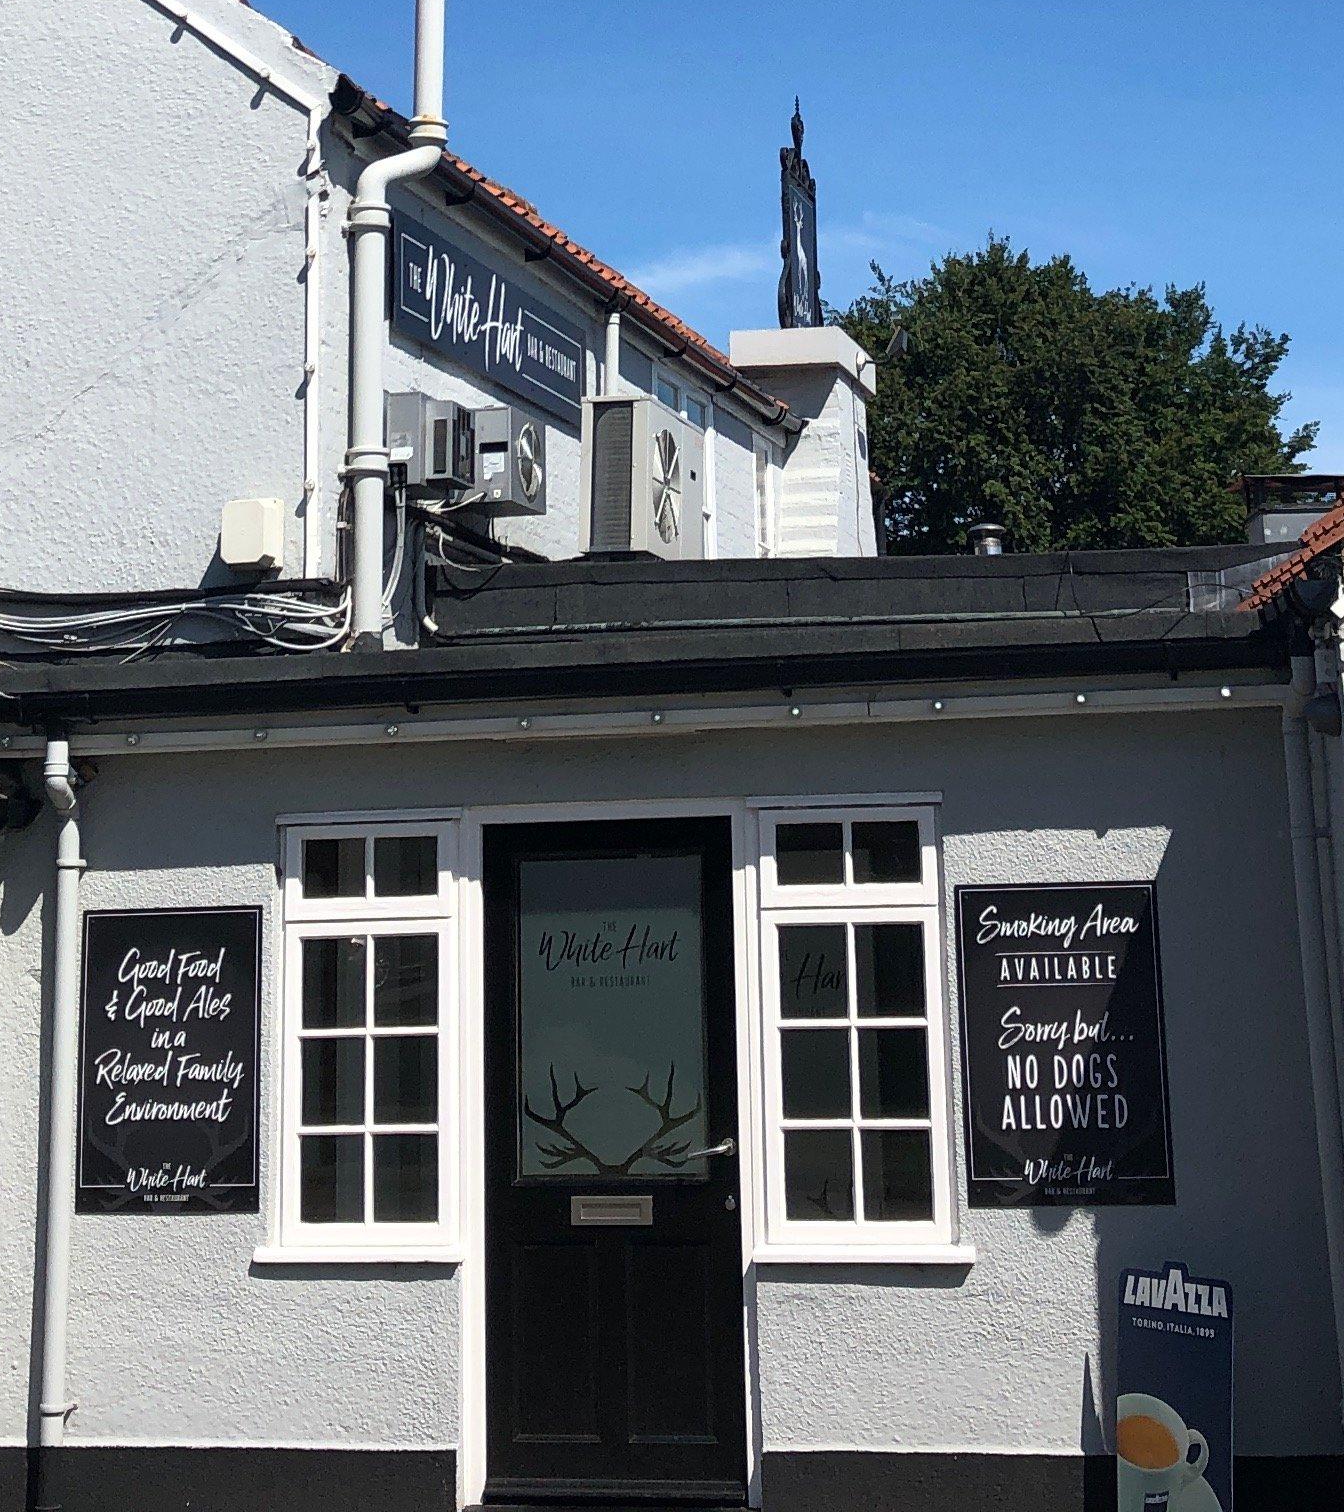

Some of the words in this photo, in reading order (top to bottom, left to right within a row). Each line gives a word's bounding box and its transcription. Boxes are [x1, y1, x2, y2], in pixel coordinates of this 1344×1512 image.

[409, 262, 422, 293] THE
[425, 244, 481, 344] White
[480, 274, 524, 372] Hart
[602, 921, 617, 933] THE
[976, 904, 1078, 948] Smoking
[1079, 903, 1139, 940] Area
[538, 930, 613, 971] White
[616, 923, 681, 969] Hart
[118, 947, 176, 990] Good
[177, 947, 226, 985] Food
[599, 975, 650, 987] RESTAURANT
[1000, 955, 1117, 981] AVAILABLE
[105, 989, 119, 1021] &
[125, 985, 182, 1029] Good
[182, 984, 233, 1022] Ales
[150, 1028, 172, 1049] in
[173, 1030, 187, 1047] a
[998, 1006, 1071, 1050] Sorry
[94, 1048, 174, 1089] Relaxed
[176, 1050, 245, 1089] Family
[1007, 1054, 1038, 1089] NO
[1054, 1053, 1118, 1089] DOGS
[105, 1088, 233, 1126] Environment
[1002, 1094, 1128, 1130] ALLOWED
[126, 1167, 170, 1192] White
[169, 1164, 207, 1192] Hart
[1024, 1158, 1071, 1185] White
[1071, 1156, 1114, 1185] Hart
[1123, 1268, 1229, 1319] LAVAZZA
